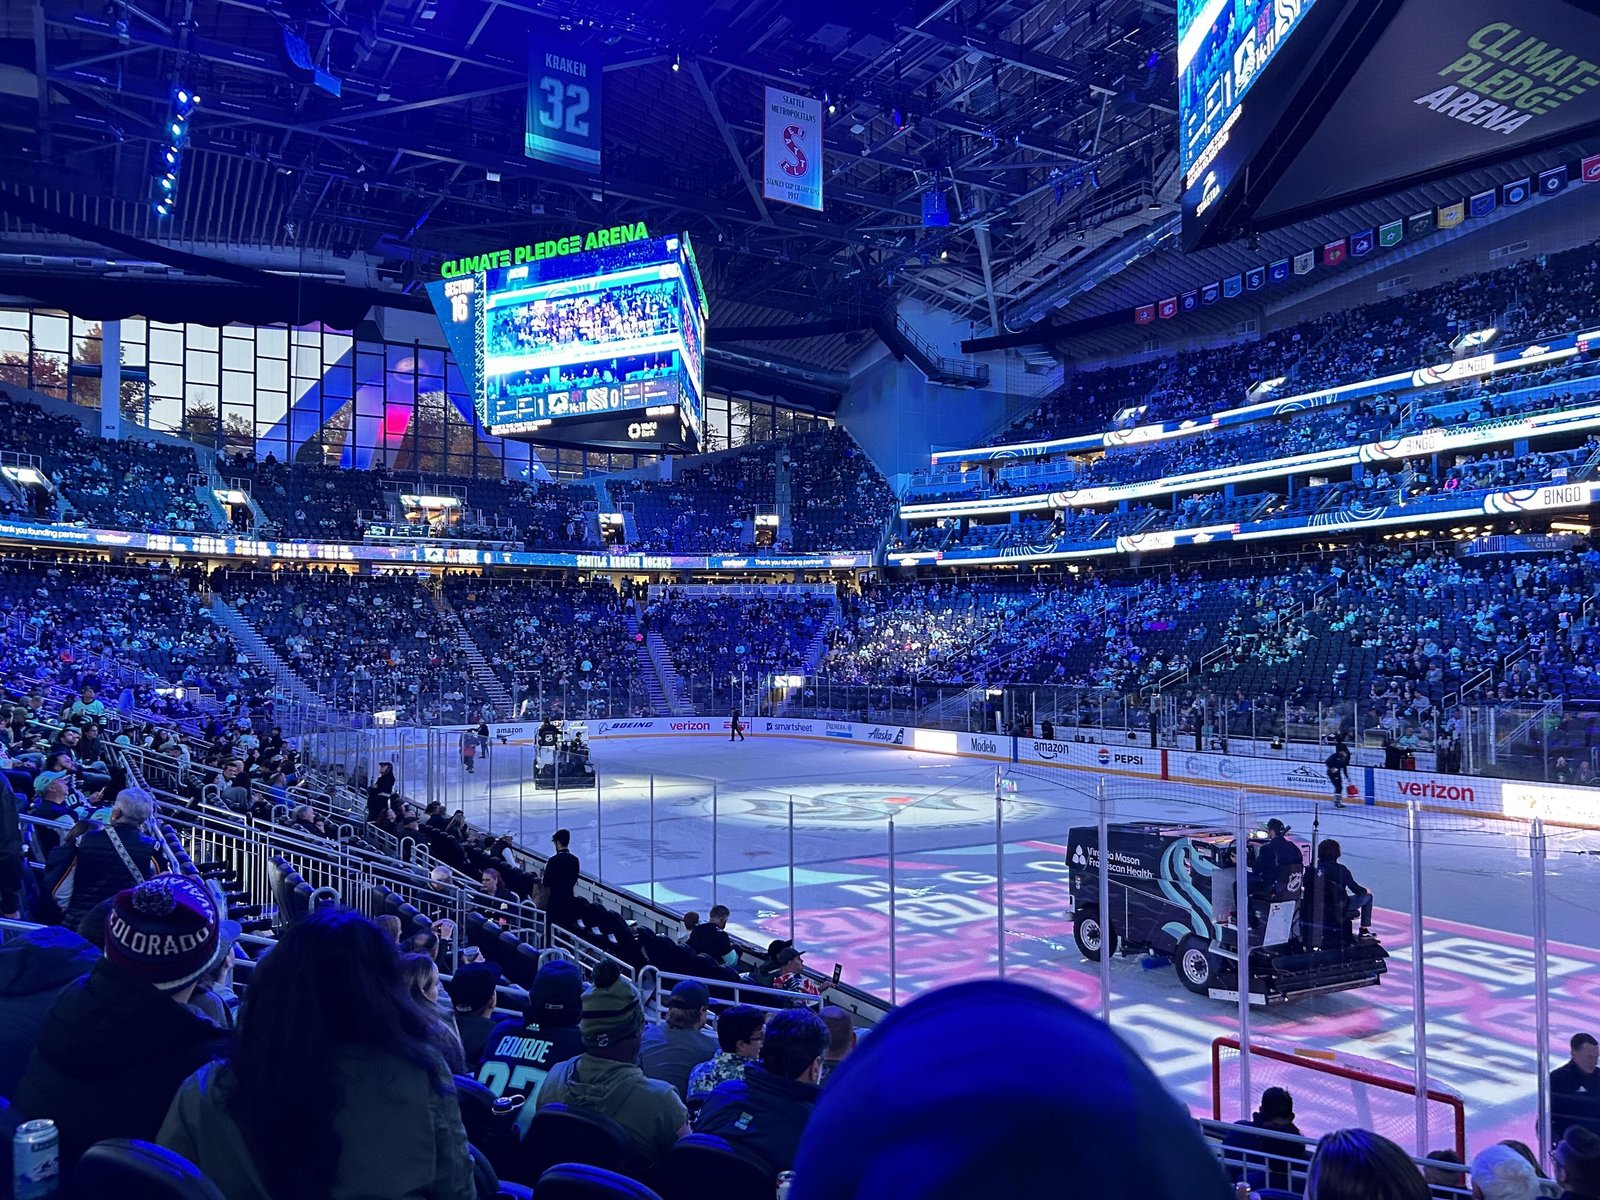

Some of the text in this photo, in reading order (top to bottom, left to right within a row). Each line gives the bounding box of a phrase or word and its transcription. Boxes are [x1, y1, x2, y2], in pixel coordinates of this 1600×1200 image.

[545, 53, 587, 78] KRAKEN
[1437, 52, 1574, 115] PLEDGE
[539, 75, 591, 137] 32
[782, 94, 806, 109] SEATTLE
[1413, 85, 1533, 135] ARENA
[770, 104, 817, 123] METROPOLITANS
[766, 178, 786, 189] STANLEY
[441, 221, 650, 279] CLIMATE PLEDGE ARENA
[445, 277, 475, 297] SECTION
[450, 294, 469, 323] 16
[1458, 358, 1487, 376] BINGO
[1406, 435, 1435, 453] BINGO
[1544, 486, 1581, 505] BINGO
[576, 554, 672, 569] SEATTLE KRAKEN HOCKEY
[496, 726, 524, 735] amazon
[611, 721, 654, 730] BOEING
[669, 720, 711, 731] verizon
[774, 722, 813, 732] smartsheet
[825, 722, 847, 731] PREMERA
[867, 727, 893, 741] Alaska
[970, 737, 997, 754] Modelo
[1033, 741, 1069, 754] amazon
[1114, 753, 1143, 765] PEPSI
[1397, 779, 1475, 802] verizon
[1115, 852, 1141, 866] Mason
[1126, 865, 1154, 879] Health
[885, 896, 999, 921] 37
[494, 1035, 554, 1064] GOURDE
